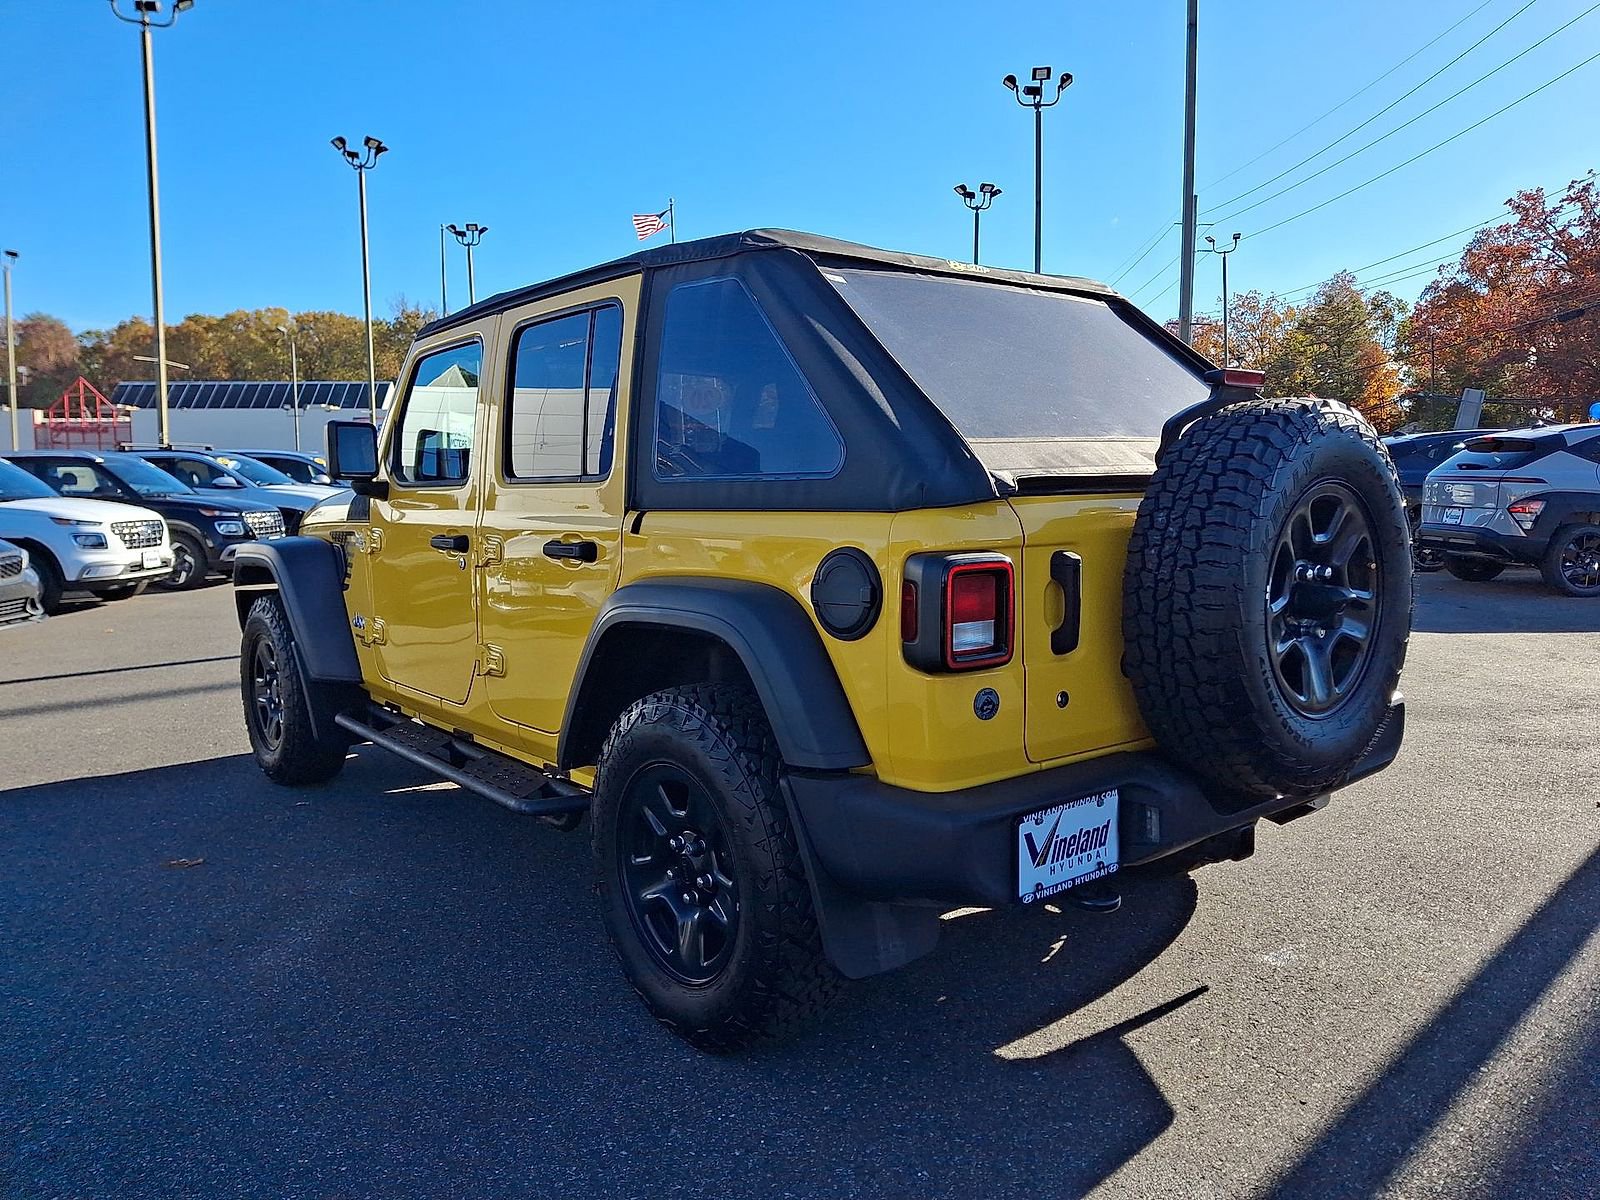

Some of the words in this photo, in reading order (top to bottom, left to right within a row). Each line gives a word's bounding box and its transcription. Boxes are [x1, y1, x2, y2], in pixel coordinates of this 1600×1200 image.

[1023, 789, 1118, 823] VINELANDHYUNDAI.COM
[1023, 808, 1111, 869] Vineland
[1049, 848, 1109, 876] HYUNDAI
[1035, 881, 1073, 899] VINELAND
[1075, 867, 1108, 886] HYUNDAI
